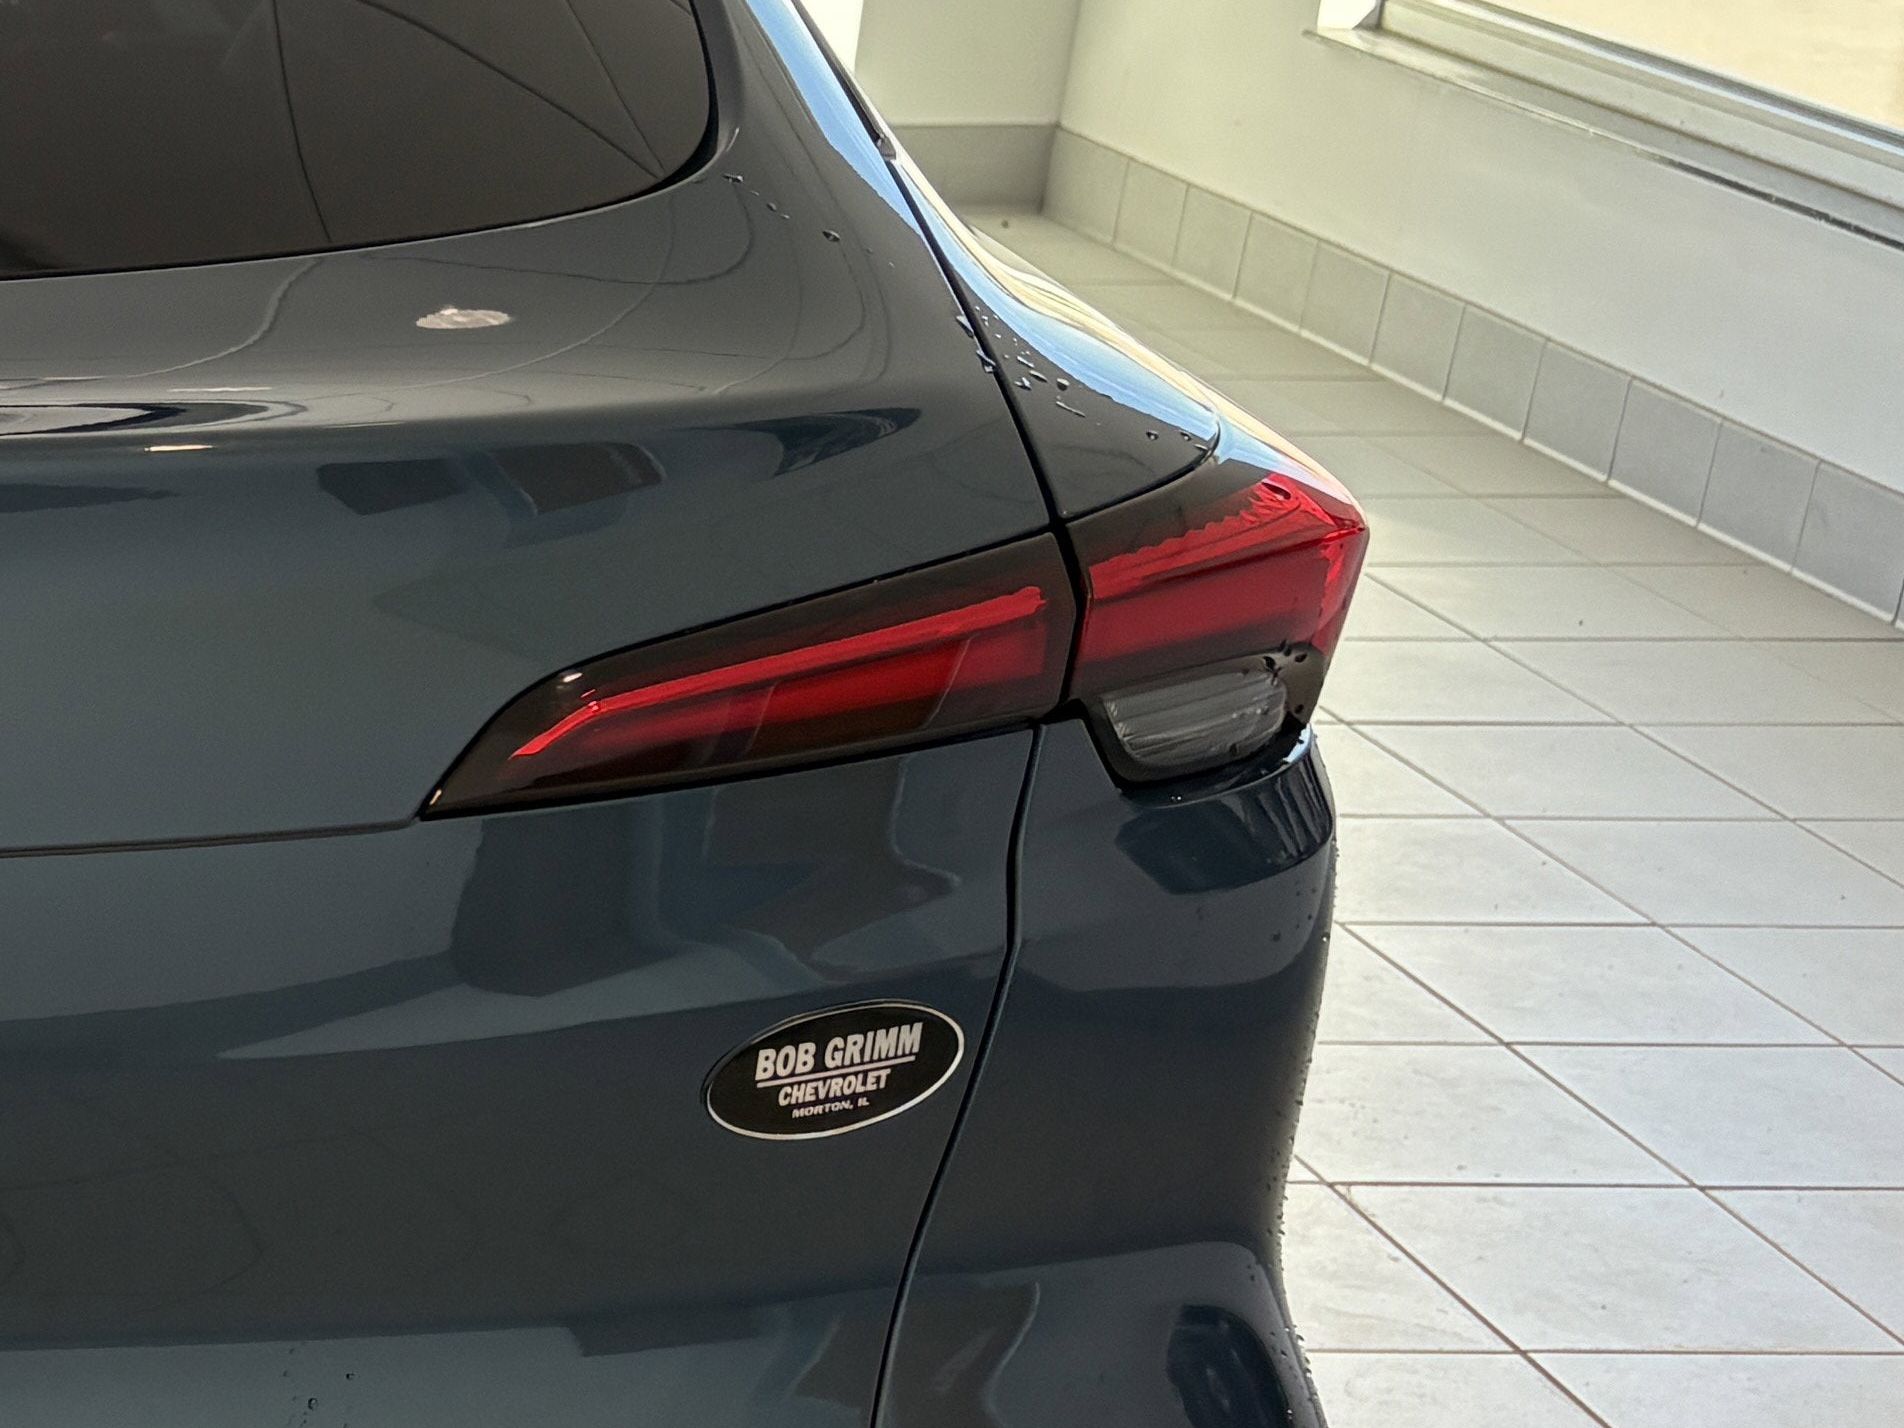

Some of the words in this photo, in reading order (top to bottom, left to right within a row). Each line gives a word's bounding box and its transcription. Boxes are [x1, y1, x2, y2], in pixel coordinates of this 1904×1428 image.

[755, 1042, 817, 1081] BOB
[824, 1022, 924, 1069] GRIMM
[778, 1068, 892, 1106] CHEVROLET
[857, 1096, 870, 1108] IL
